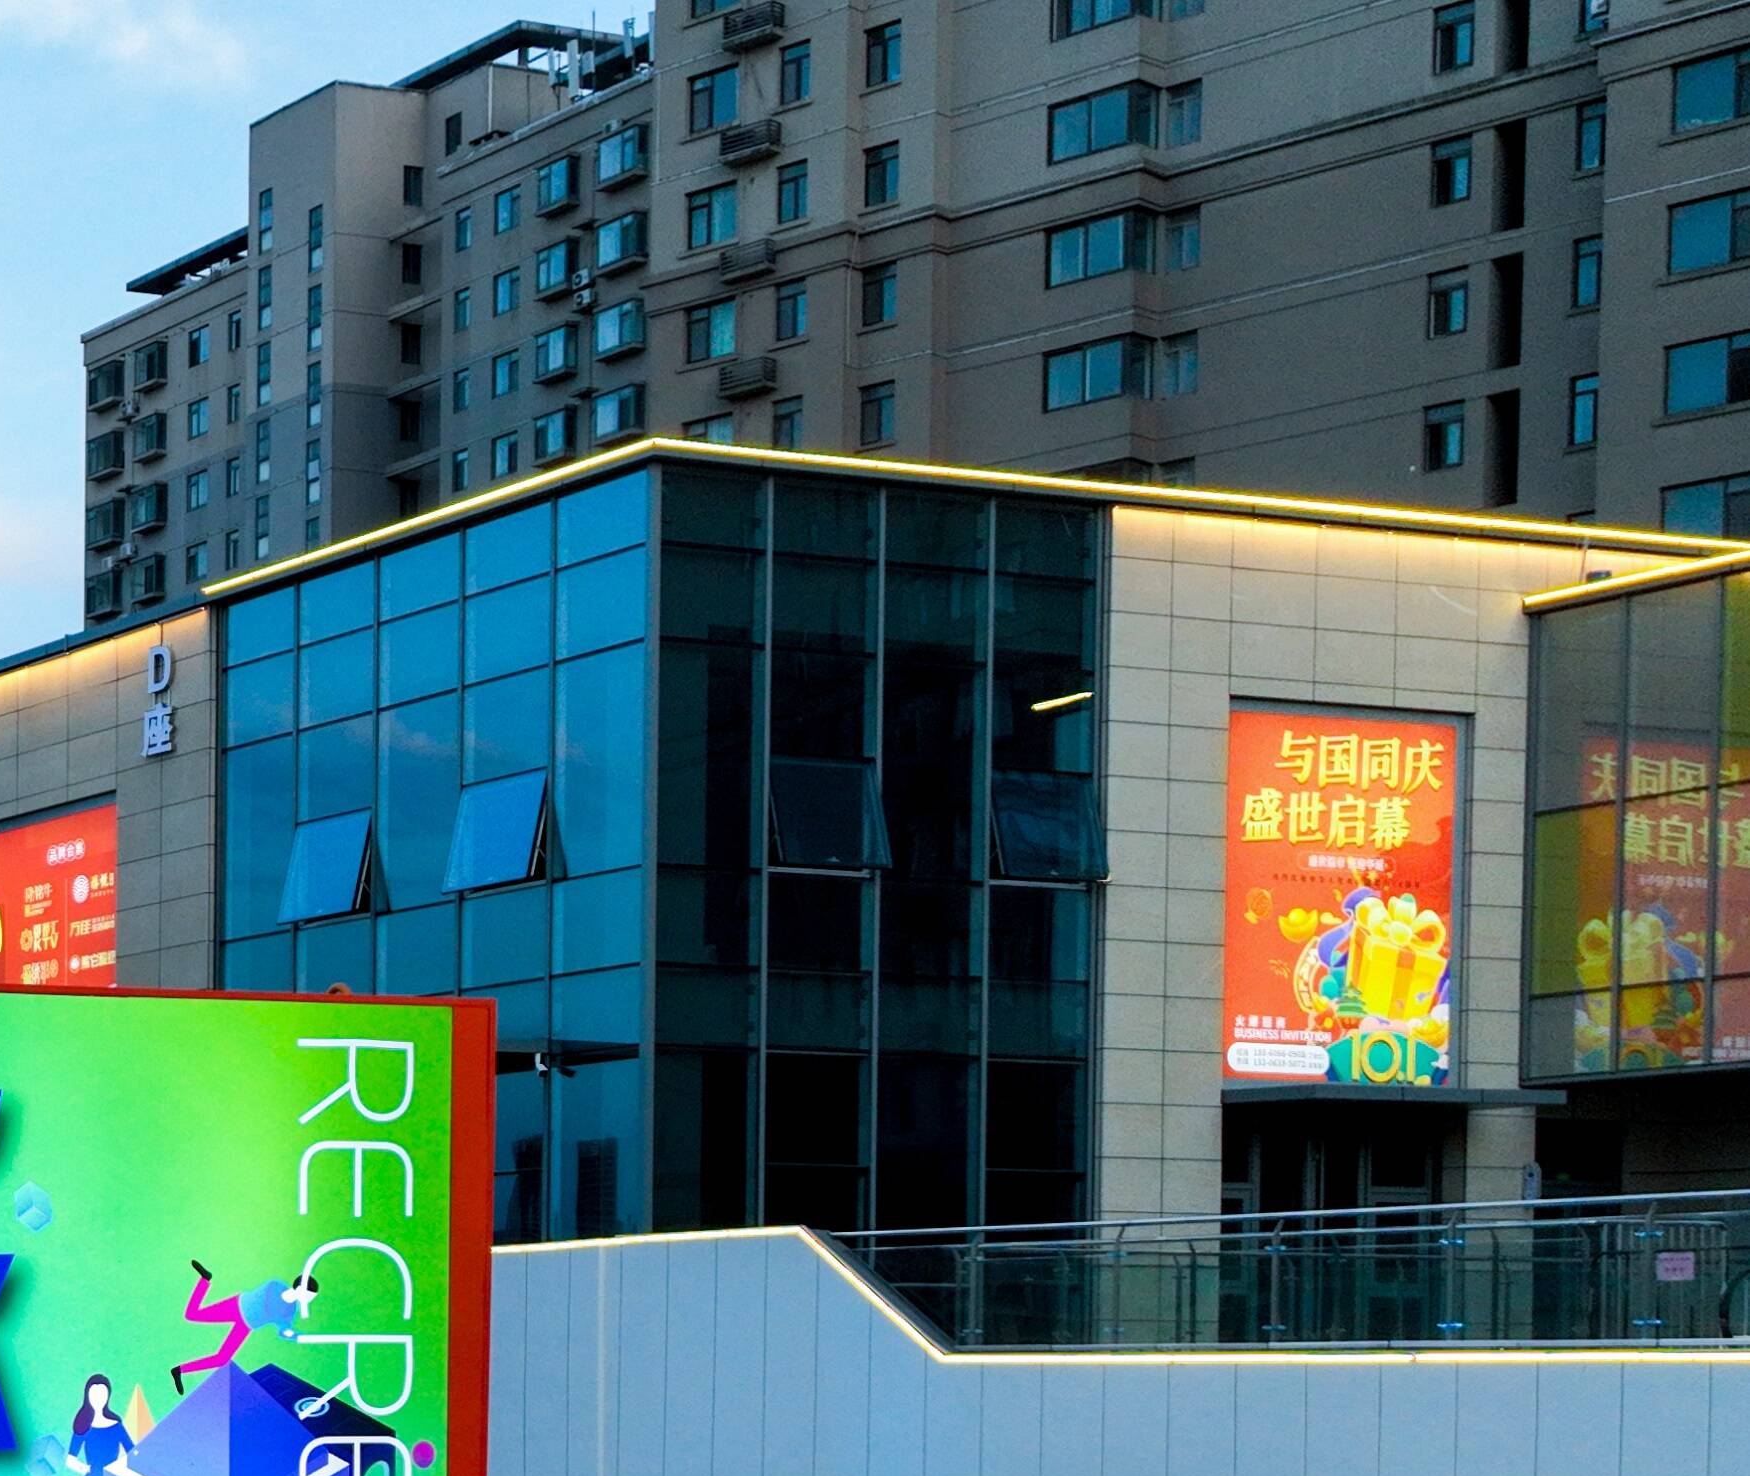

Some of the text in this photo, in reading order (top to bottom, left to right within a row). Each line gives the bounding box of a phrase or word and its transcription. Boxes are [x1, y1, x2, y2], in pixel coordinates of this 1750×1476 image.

[141, 645, 173, 758] D座
[1274, 730, 1444, 793] 与国同庆
[1240, 787, 1412, 849] 盛世启幕
